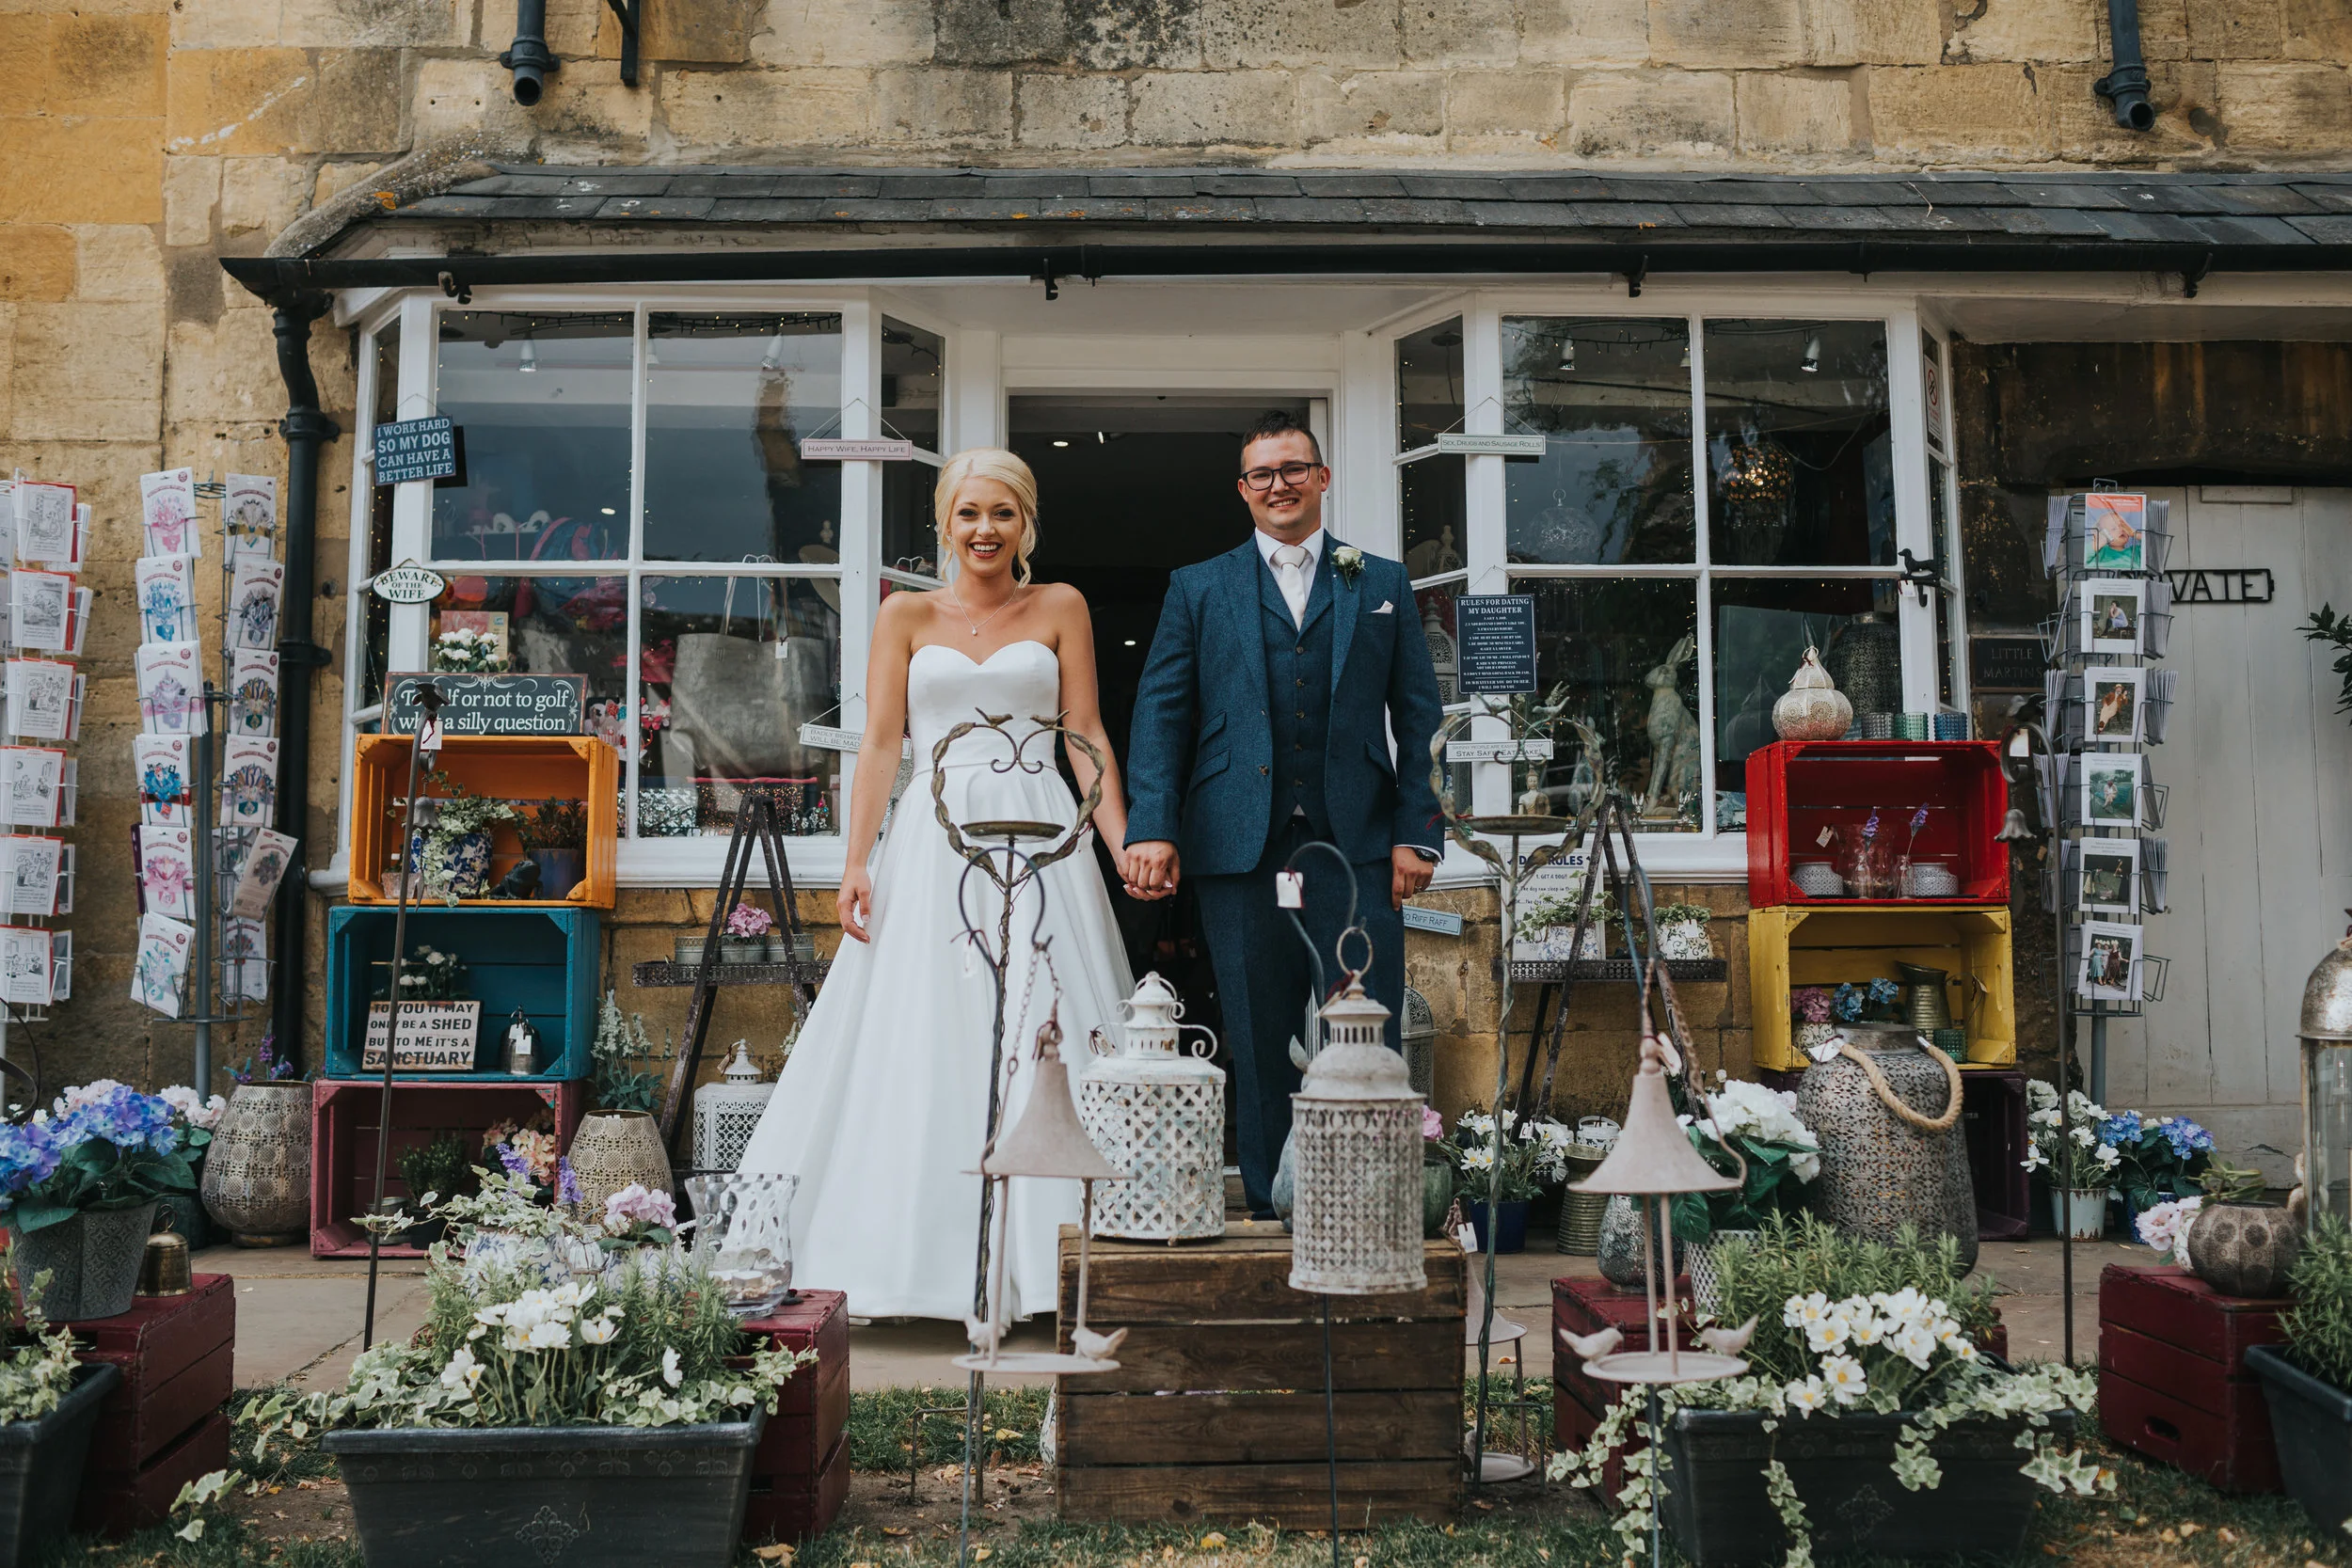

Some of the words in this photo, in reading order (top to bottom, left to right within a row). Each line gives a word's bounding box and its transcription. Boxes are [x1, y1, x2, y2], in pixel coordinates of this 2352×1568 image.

[377, 428, 381, 437] I
[383, 423, 416, 436] WORK
[418, 419, 450, 432] HARD
[378, 439, 396, 453] SO
[399, 435, 419, 451] MY
[422, 432, 451, 447] DOG
[378, 454, 404, 468] CAN
[406, 450, 439, 464] HAVE
[442, 448, 451, 459] A
[378, 467, 423, 483] BETTER
[426, 462, 452, 476] LIFE
[380, 571, 438, 587] BEWARE
[389, 589, 425, 599] WIFE
[1991, 647, 2033, 659] LITTLE
[1983, 666, 2042, 678] MARTINS
[461, 694, 481, 707] or
[483, 691, 512, 707] not
[515, 691, 532, 707] to
[534, 689, 570, 712] golf
[398, 711, 442, 729] wht
[444, 717, 454, 730] a
[457, 712, 492, 735] silly
[494, 713, 565, 733] question
[834, 732, 862, 741] BEHAVE
[1548, 855, 1583, 865] RULES
[1403, 912, 1411, 921] O
[1412, 914, 1428, 923] RIFF
[1430, 916, 1448, 927] RAFF
[374, 1004, 389, 1014] TO
[397, 1003, 425, 1014] YOU
[429, 1004, 439, 1013] IT
[445, 1004, 474, 1013] MAY
[419, 1021, 427, 1029] A
[431, 1019, 472, 1029] SHED
[396, 1037, 410, 1046] TO
[415, 1037, 432, 1046] ME
[436, 1038, 458, 1047] IT'S
[461, 1038, 469, 1046] A
[365, 1051, 471, 1065] SANCTUARY
